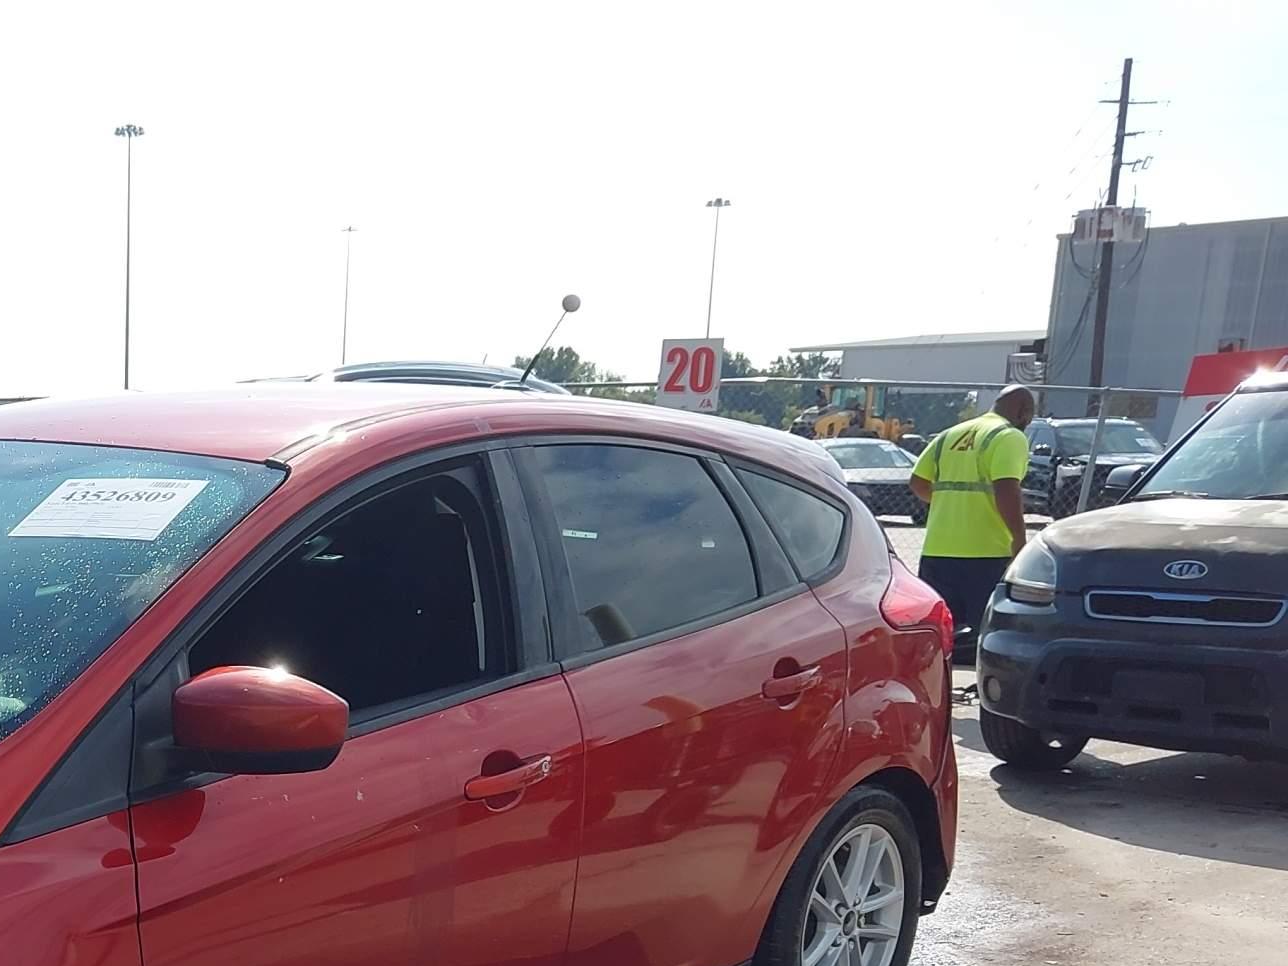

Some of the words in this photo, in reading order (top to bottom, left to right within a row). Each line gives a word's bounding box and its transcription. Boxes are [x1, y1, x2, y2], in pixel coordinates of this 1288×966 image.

[663, 346, 715, 393] 20
[60, 490, 177, 503] 43526809
[1169, 563, 1201, 577] KIA
